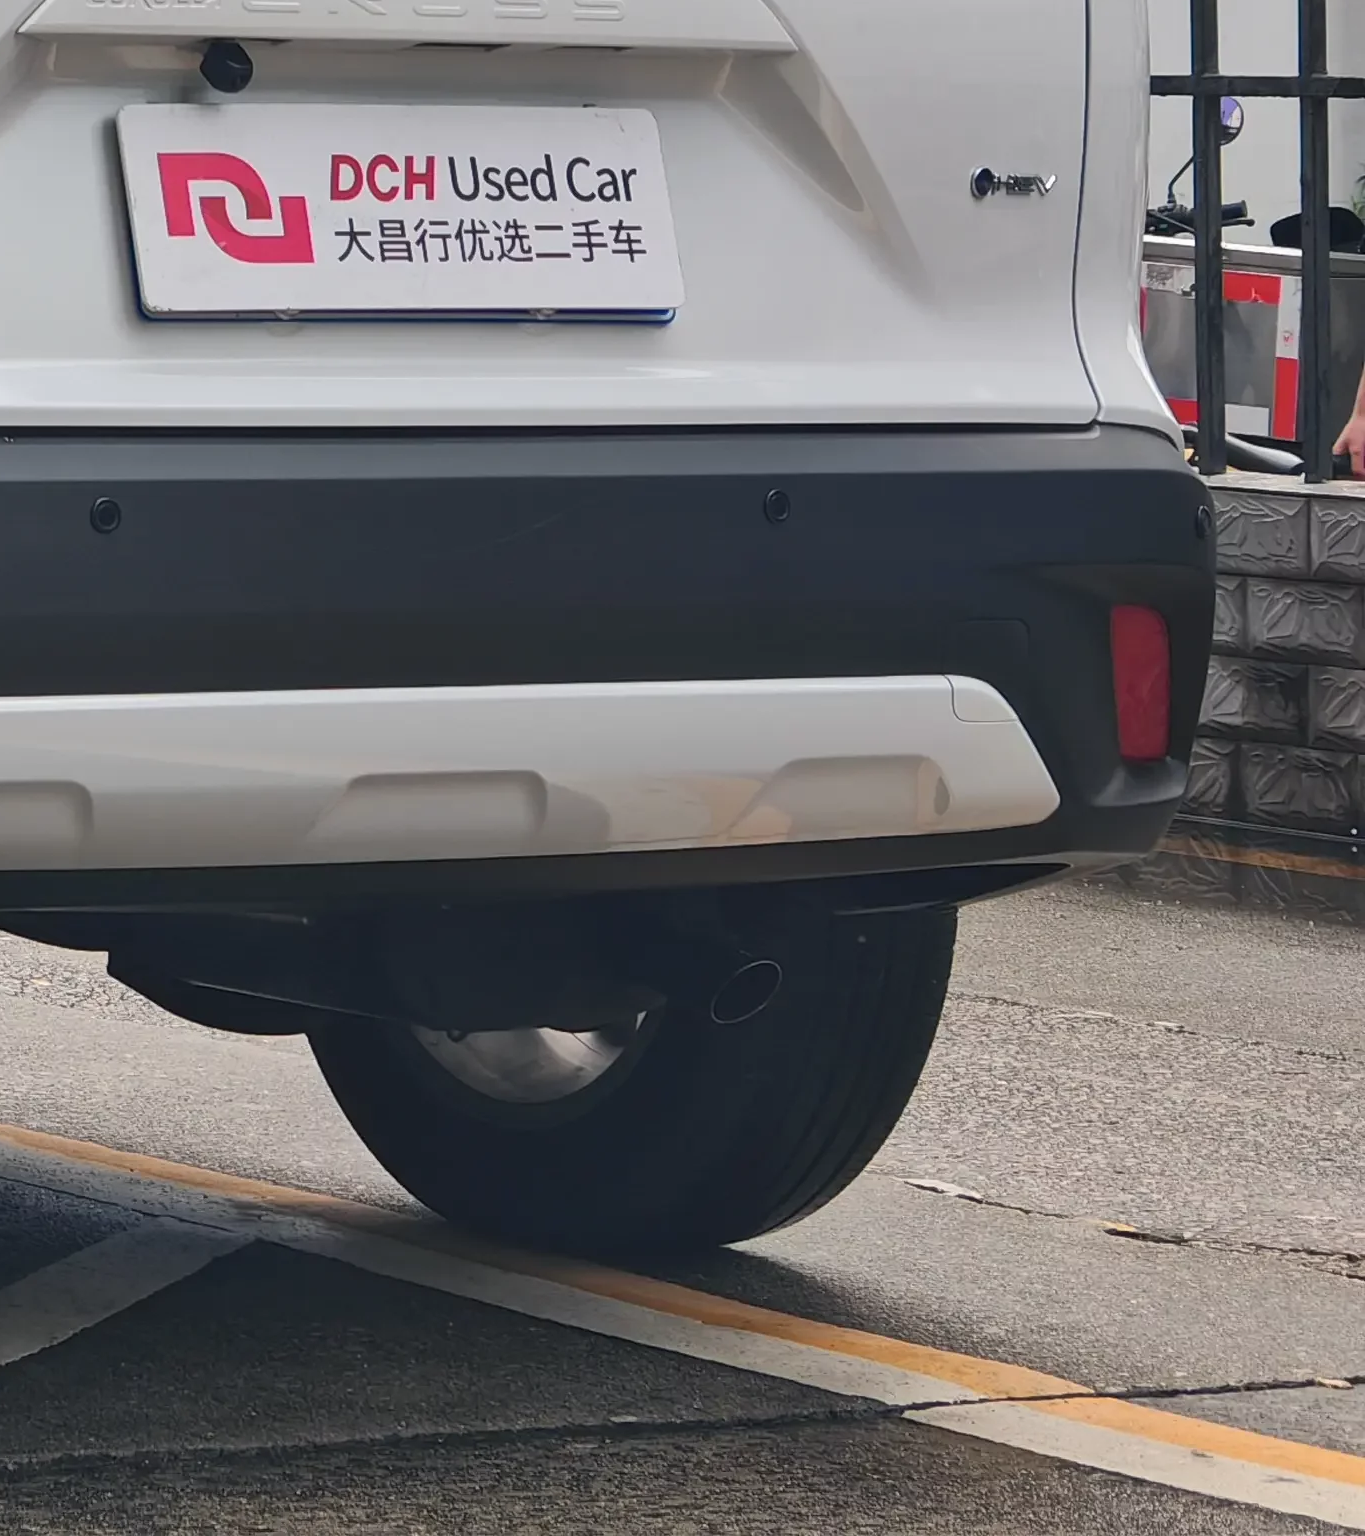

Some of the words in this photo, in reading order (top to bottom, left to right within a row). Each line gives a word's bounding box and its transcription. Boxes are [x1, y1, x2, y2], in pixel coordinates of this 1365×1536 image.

[330, 153, 436, 202] DCH
[448, 154, 558, 202] Used
[566, 156, 637, 202] Car
[334, 217, 647, 263] 大昌行优选二手车
